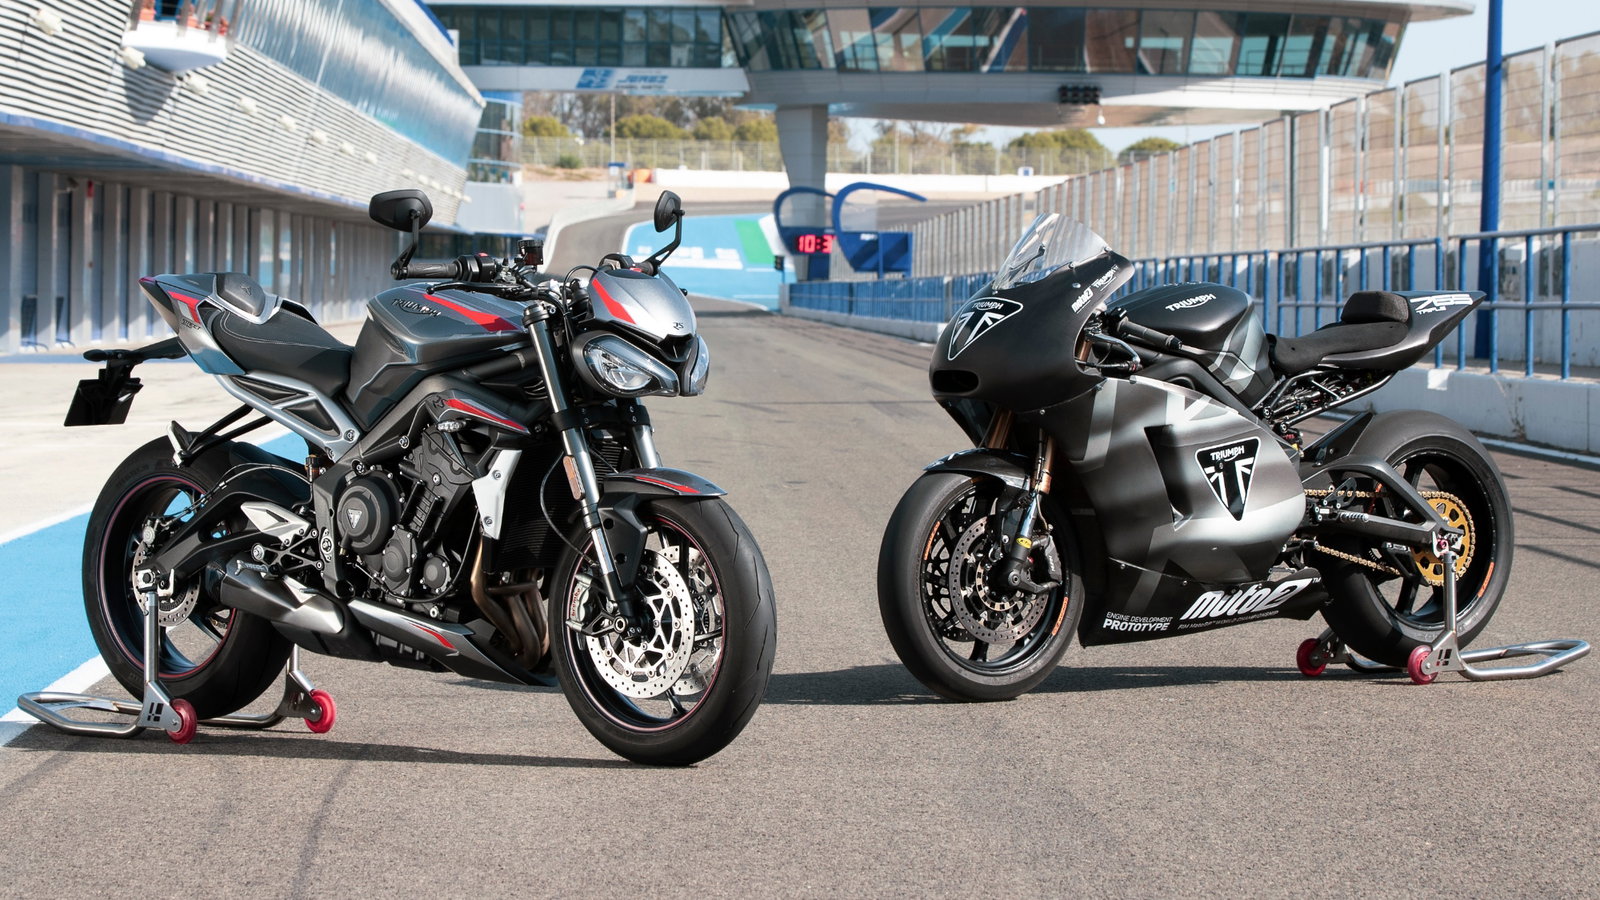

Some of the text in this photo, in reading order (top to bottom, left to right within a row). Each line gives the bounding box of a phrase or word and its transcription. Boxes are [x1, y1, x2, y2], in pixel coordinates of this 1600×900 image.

[798, 234, 837, 253] 10:3
[972, 301, 1004, 311] TRIUMPH
[1165, 293, 1217, 311] TRIUMPH
[1410, 294, 1474, 310] 765
[1210, 445, 1245, 462] TRIUMPH
[1106, 611, 1130, 622] ENGINE
[1103, 618, 1170, 632] PROTOTYPE
